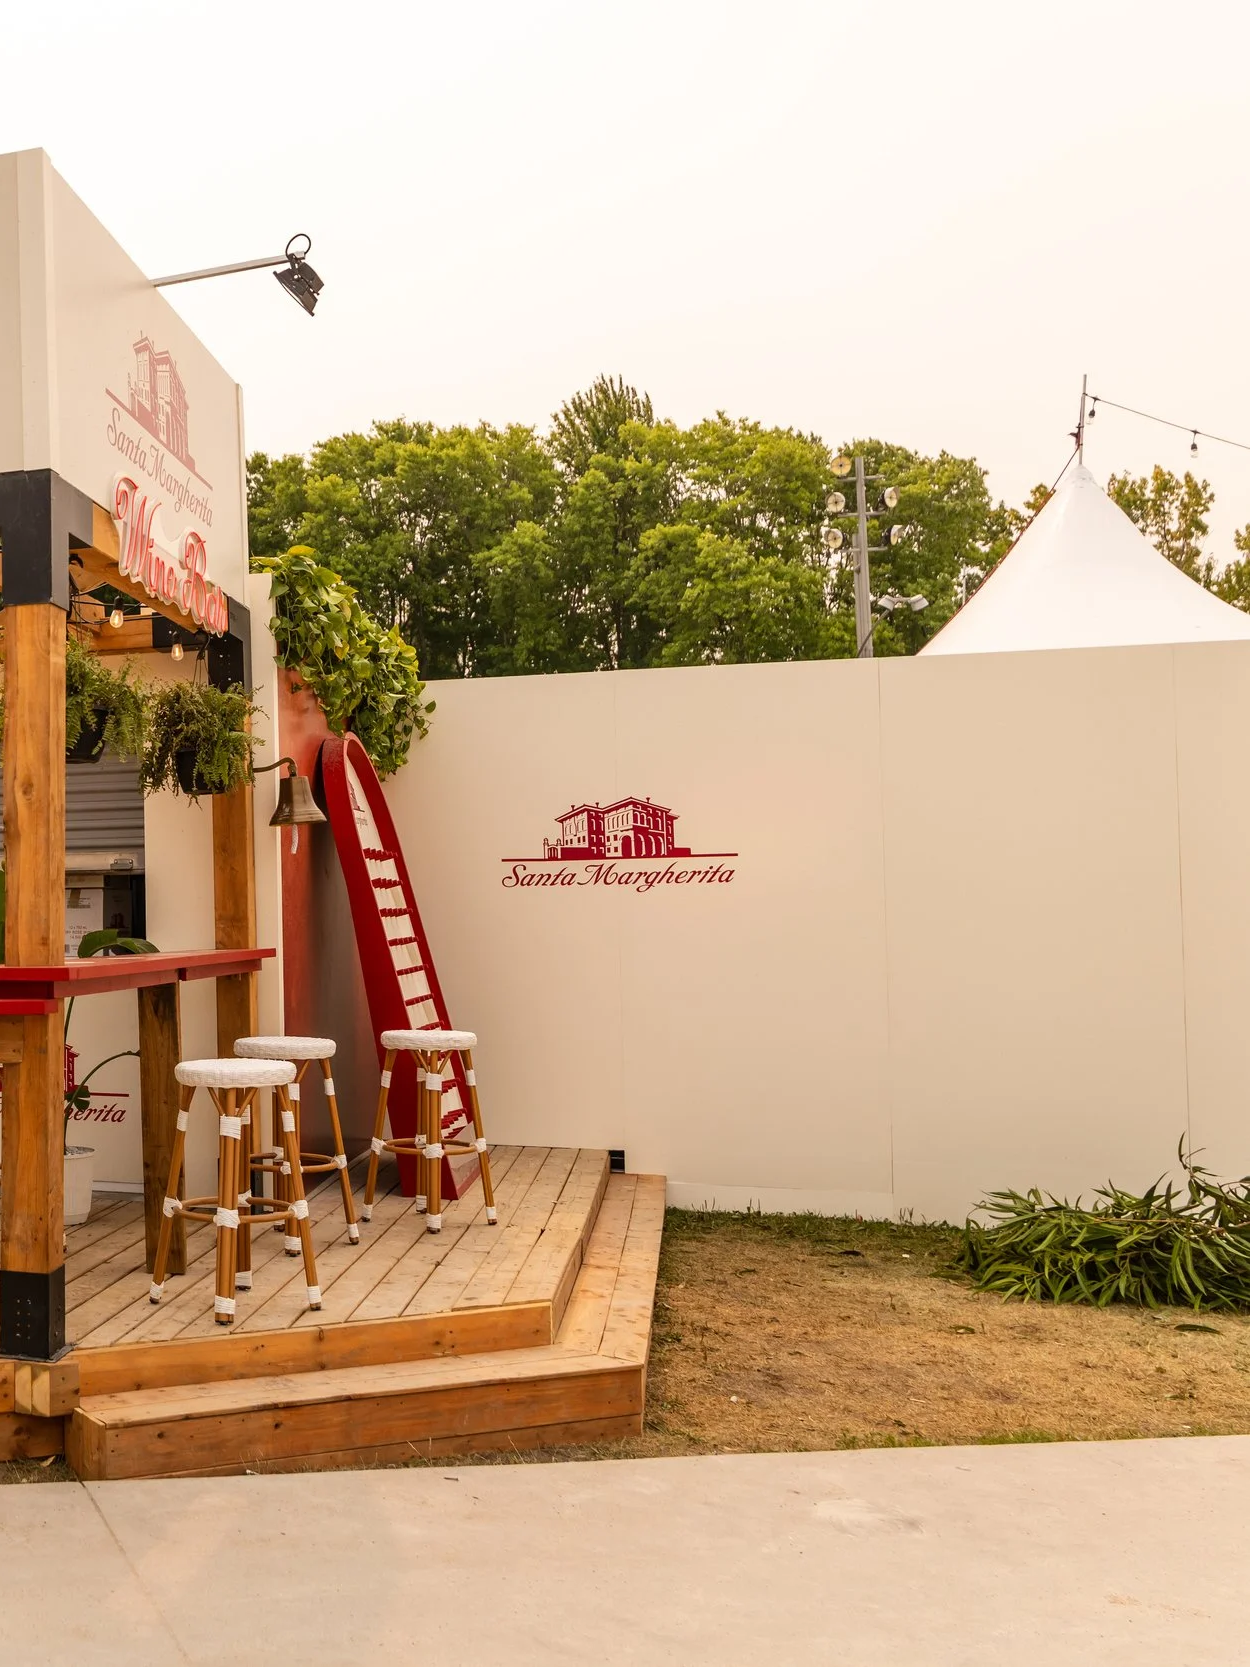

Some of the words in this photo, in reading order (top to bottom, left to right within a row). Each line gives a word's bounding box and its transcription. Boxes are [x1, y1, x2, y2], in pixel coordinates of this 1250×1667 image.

[107, 407, 146, 471] Santa
[146, 444, 213, 529] Margherita
[115, 476, 176, 599] Wine
[182, 530, 229, 636] Bar
[501, 863, 576, 888] Santa
[576, 861, 735, 893] Margherita
